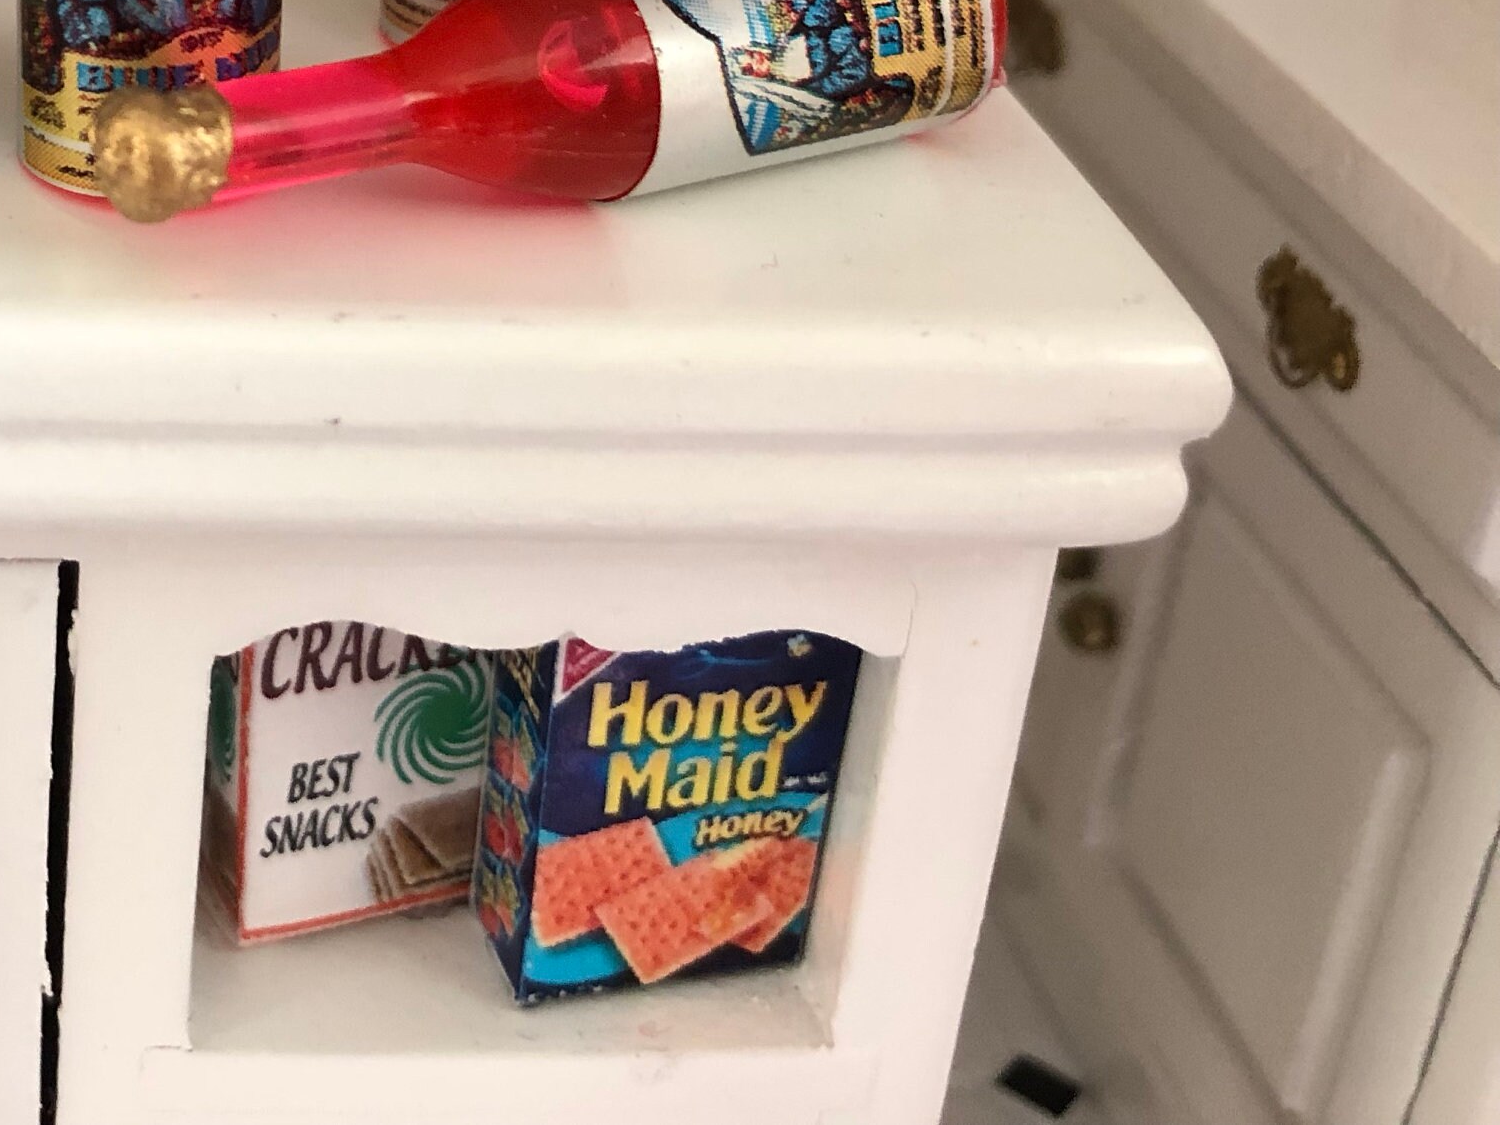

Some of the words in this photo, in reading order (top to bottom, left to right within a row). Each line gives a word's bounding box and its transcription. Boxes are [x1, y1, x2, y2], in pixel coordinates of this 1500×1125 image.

[587, 679, 829, 749] Honey
[287, 750, 362, 805] BEST
[603, 731, 787, 816] Maid
[260, 795, 380, 859] SNACKS
[696, 809, 805, 848] Honey
